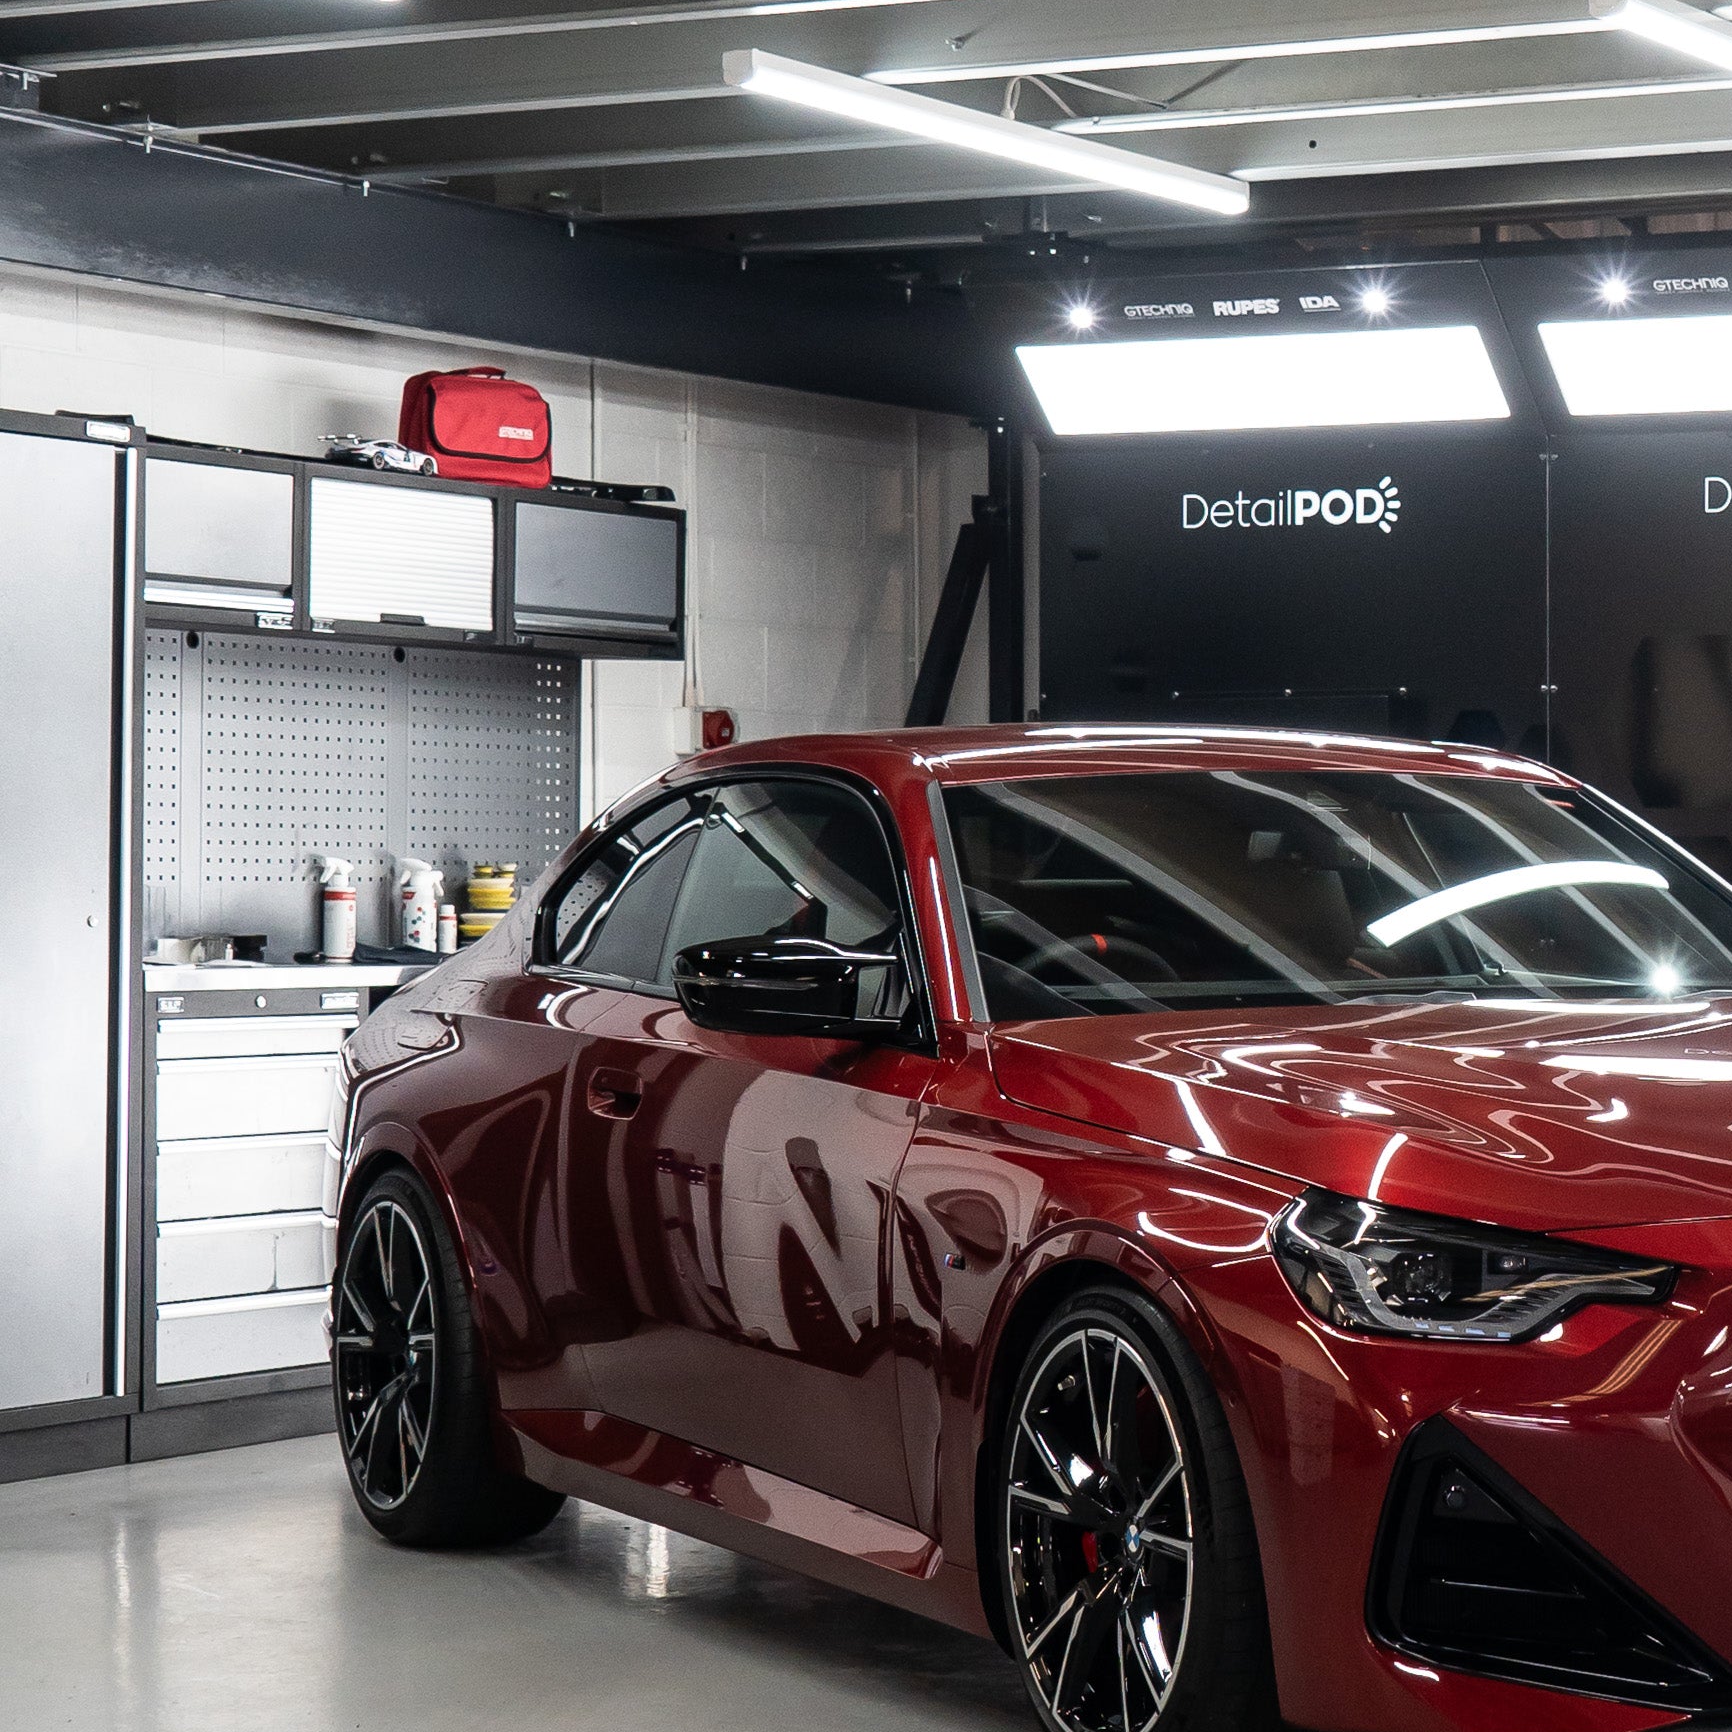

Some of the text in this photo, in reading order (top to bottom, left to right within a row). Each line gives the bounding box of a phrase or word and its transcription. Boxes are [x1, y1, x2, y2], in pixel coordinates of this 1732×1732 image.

[1212, 298, 1279, 317] RUPES
[1298, 295, 1341, 310] IDA
[1182, 488, 1386, 529] DetailPOD
